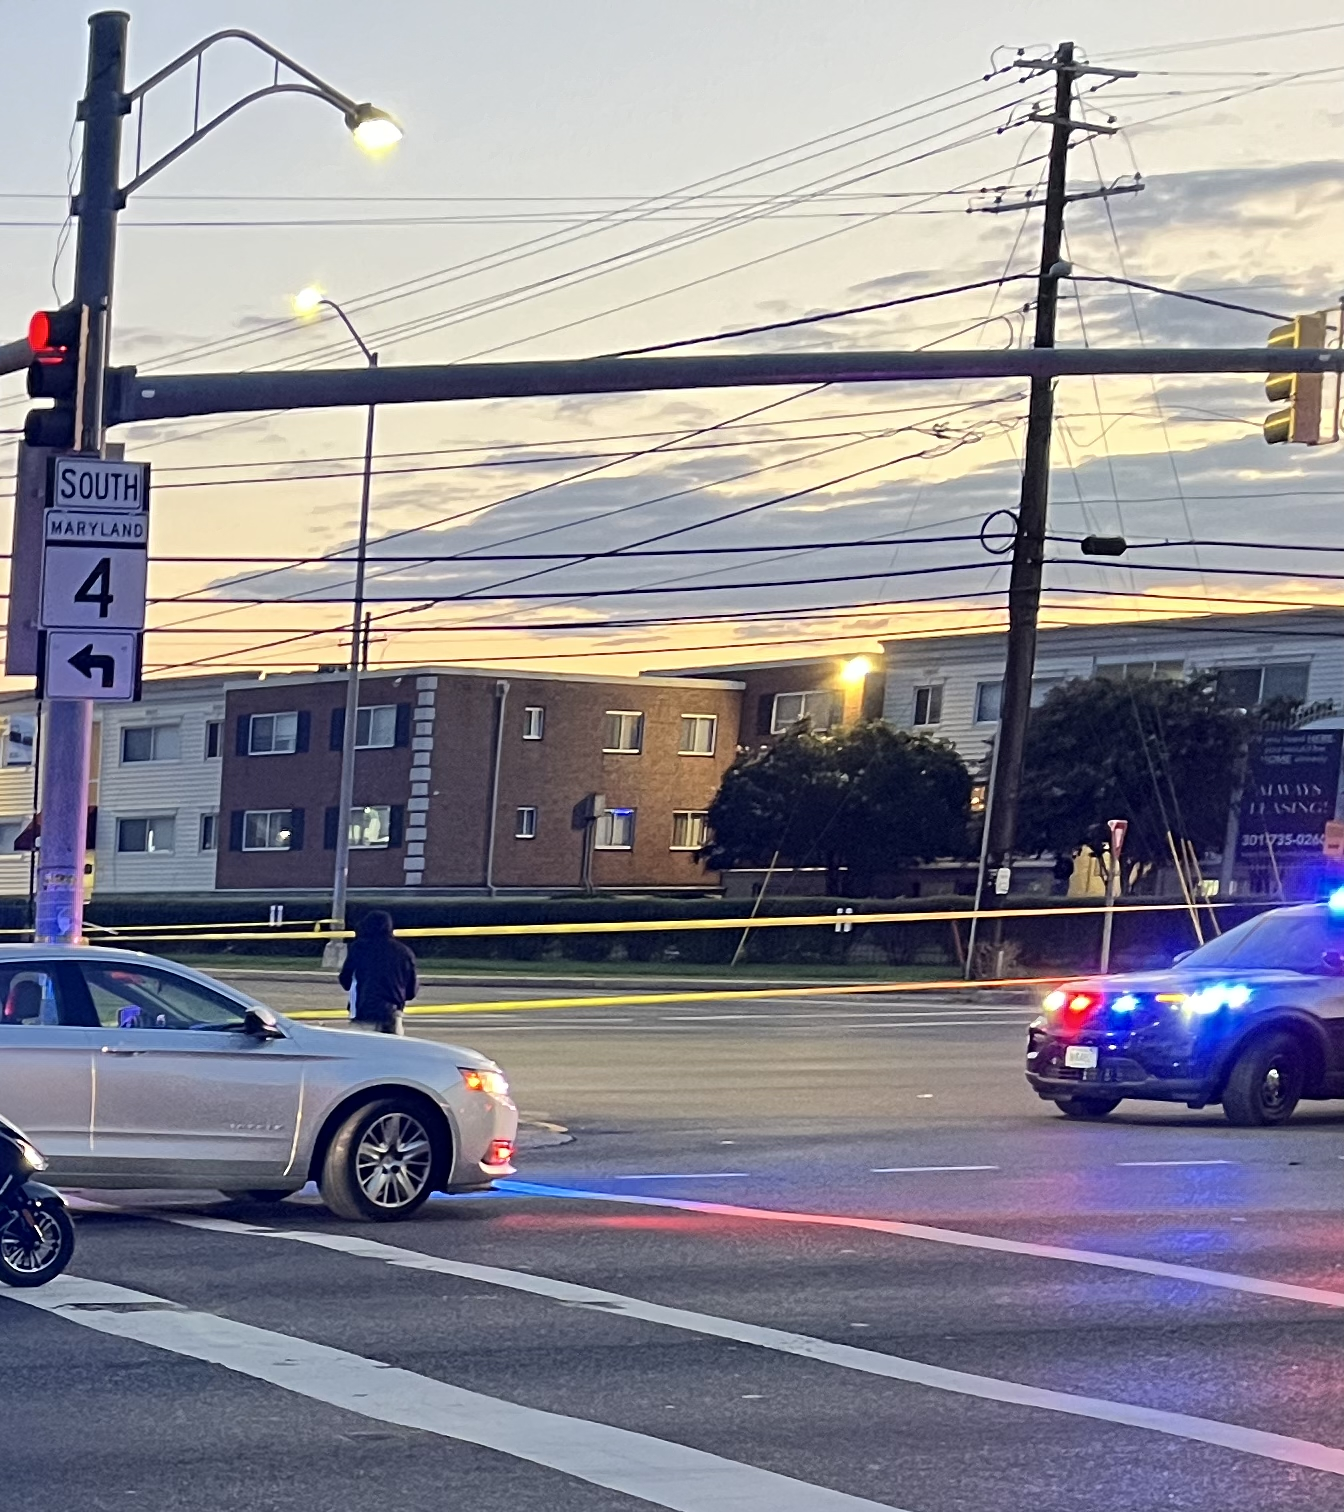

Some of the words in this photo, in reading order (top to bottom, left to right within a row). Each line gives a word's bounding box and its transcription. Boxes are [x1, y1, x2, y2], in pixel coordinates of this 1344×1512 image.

[61, 468, 138, 501] SOUTH
[50, 520, 143, 538] MARYLAND
[74, 557, 114, 619] 4
